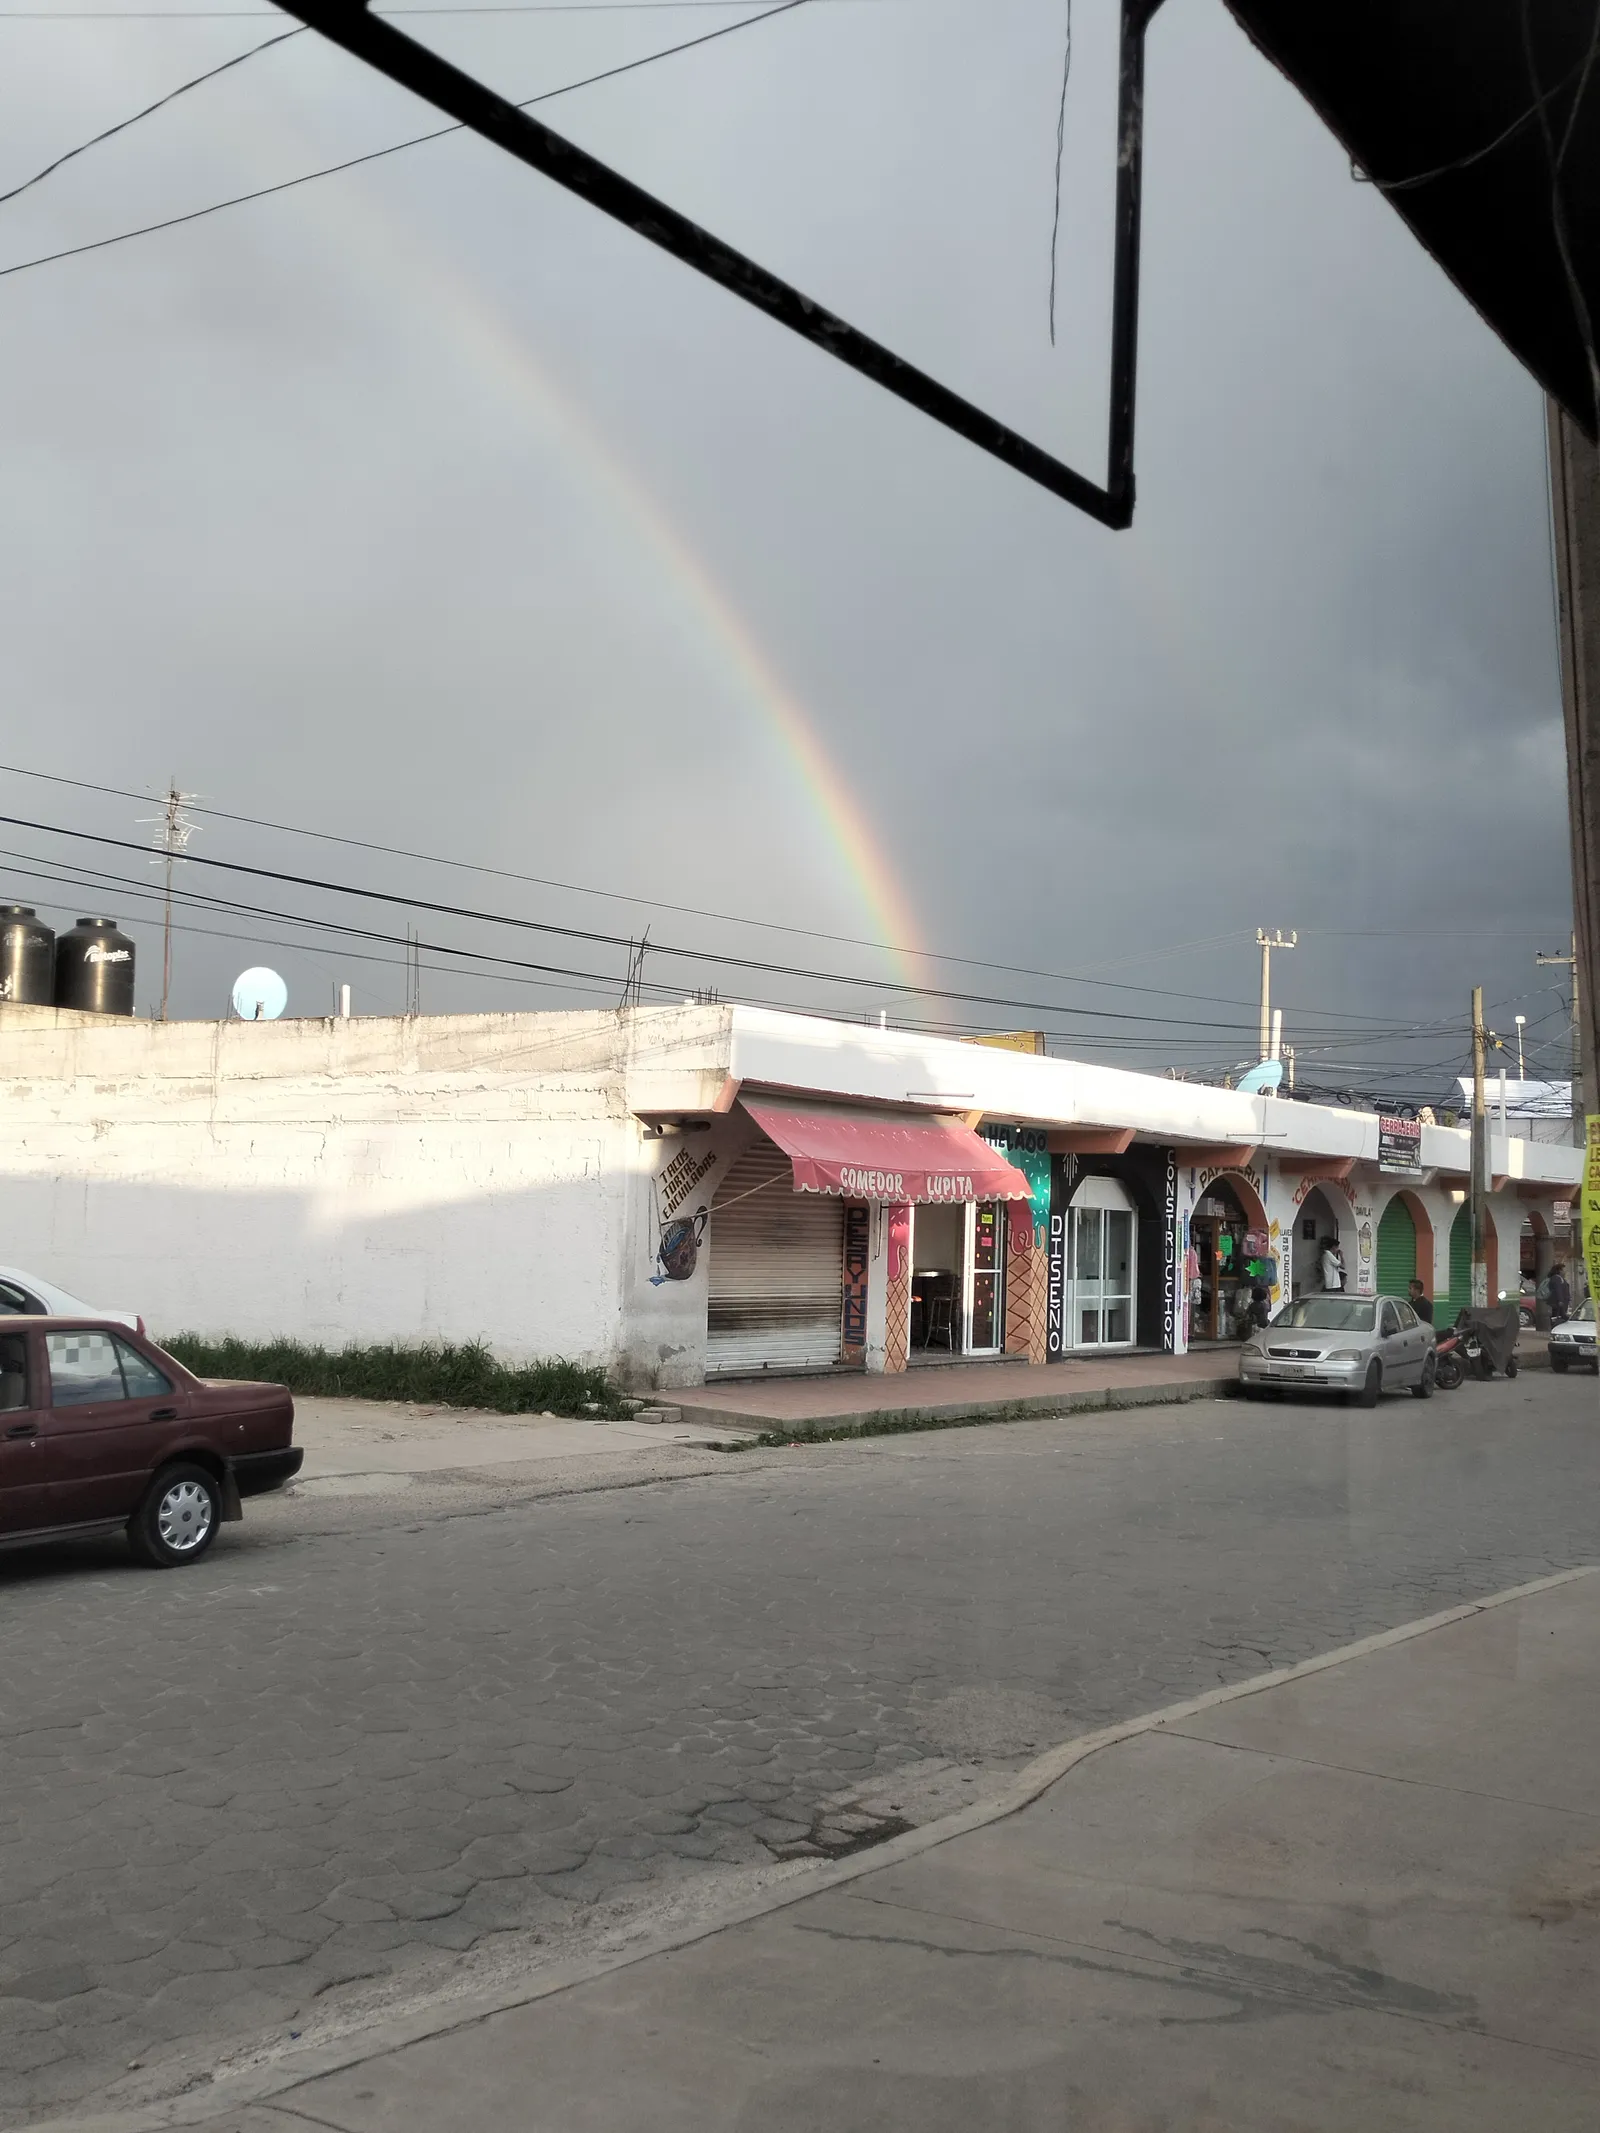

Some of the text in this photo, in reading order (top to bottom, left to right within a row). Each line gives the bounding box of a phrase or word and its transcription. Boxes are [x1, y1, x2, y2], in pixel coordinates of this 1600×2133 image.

[659, 1147, 690, 1184] TACOS
[661, 1156, 698, 1200] TORTAS
[662, 1150, 718, 1220] ENCHILADAS
[840, 1167, 973, 1196] COMEDOR LUPITA
[845, 1207, 868, 1346] DESAYUNOS
[1049, 1215, 1063, 1352] DISEÑO
[1163, 1150, 1175, 1350] CONSTRUCCION
